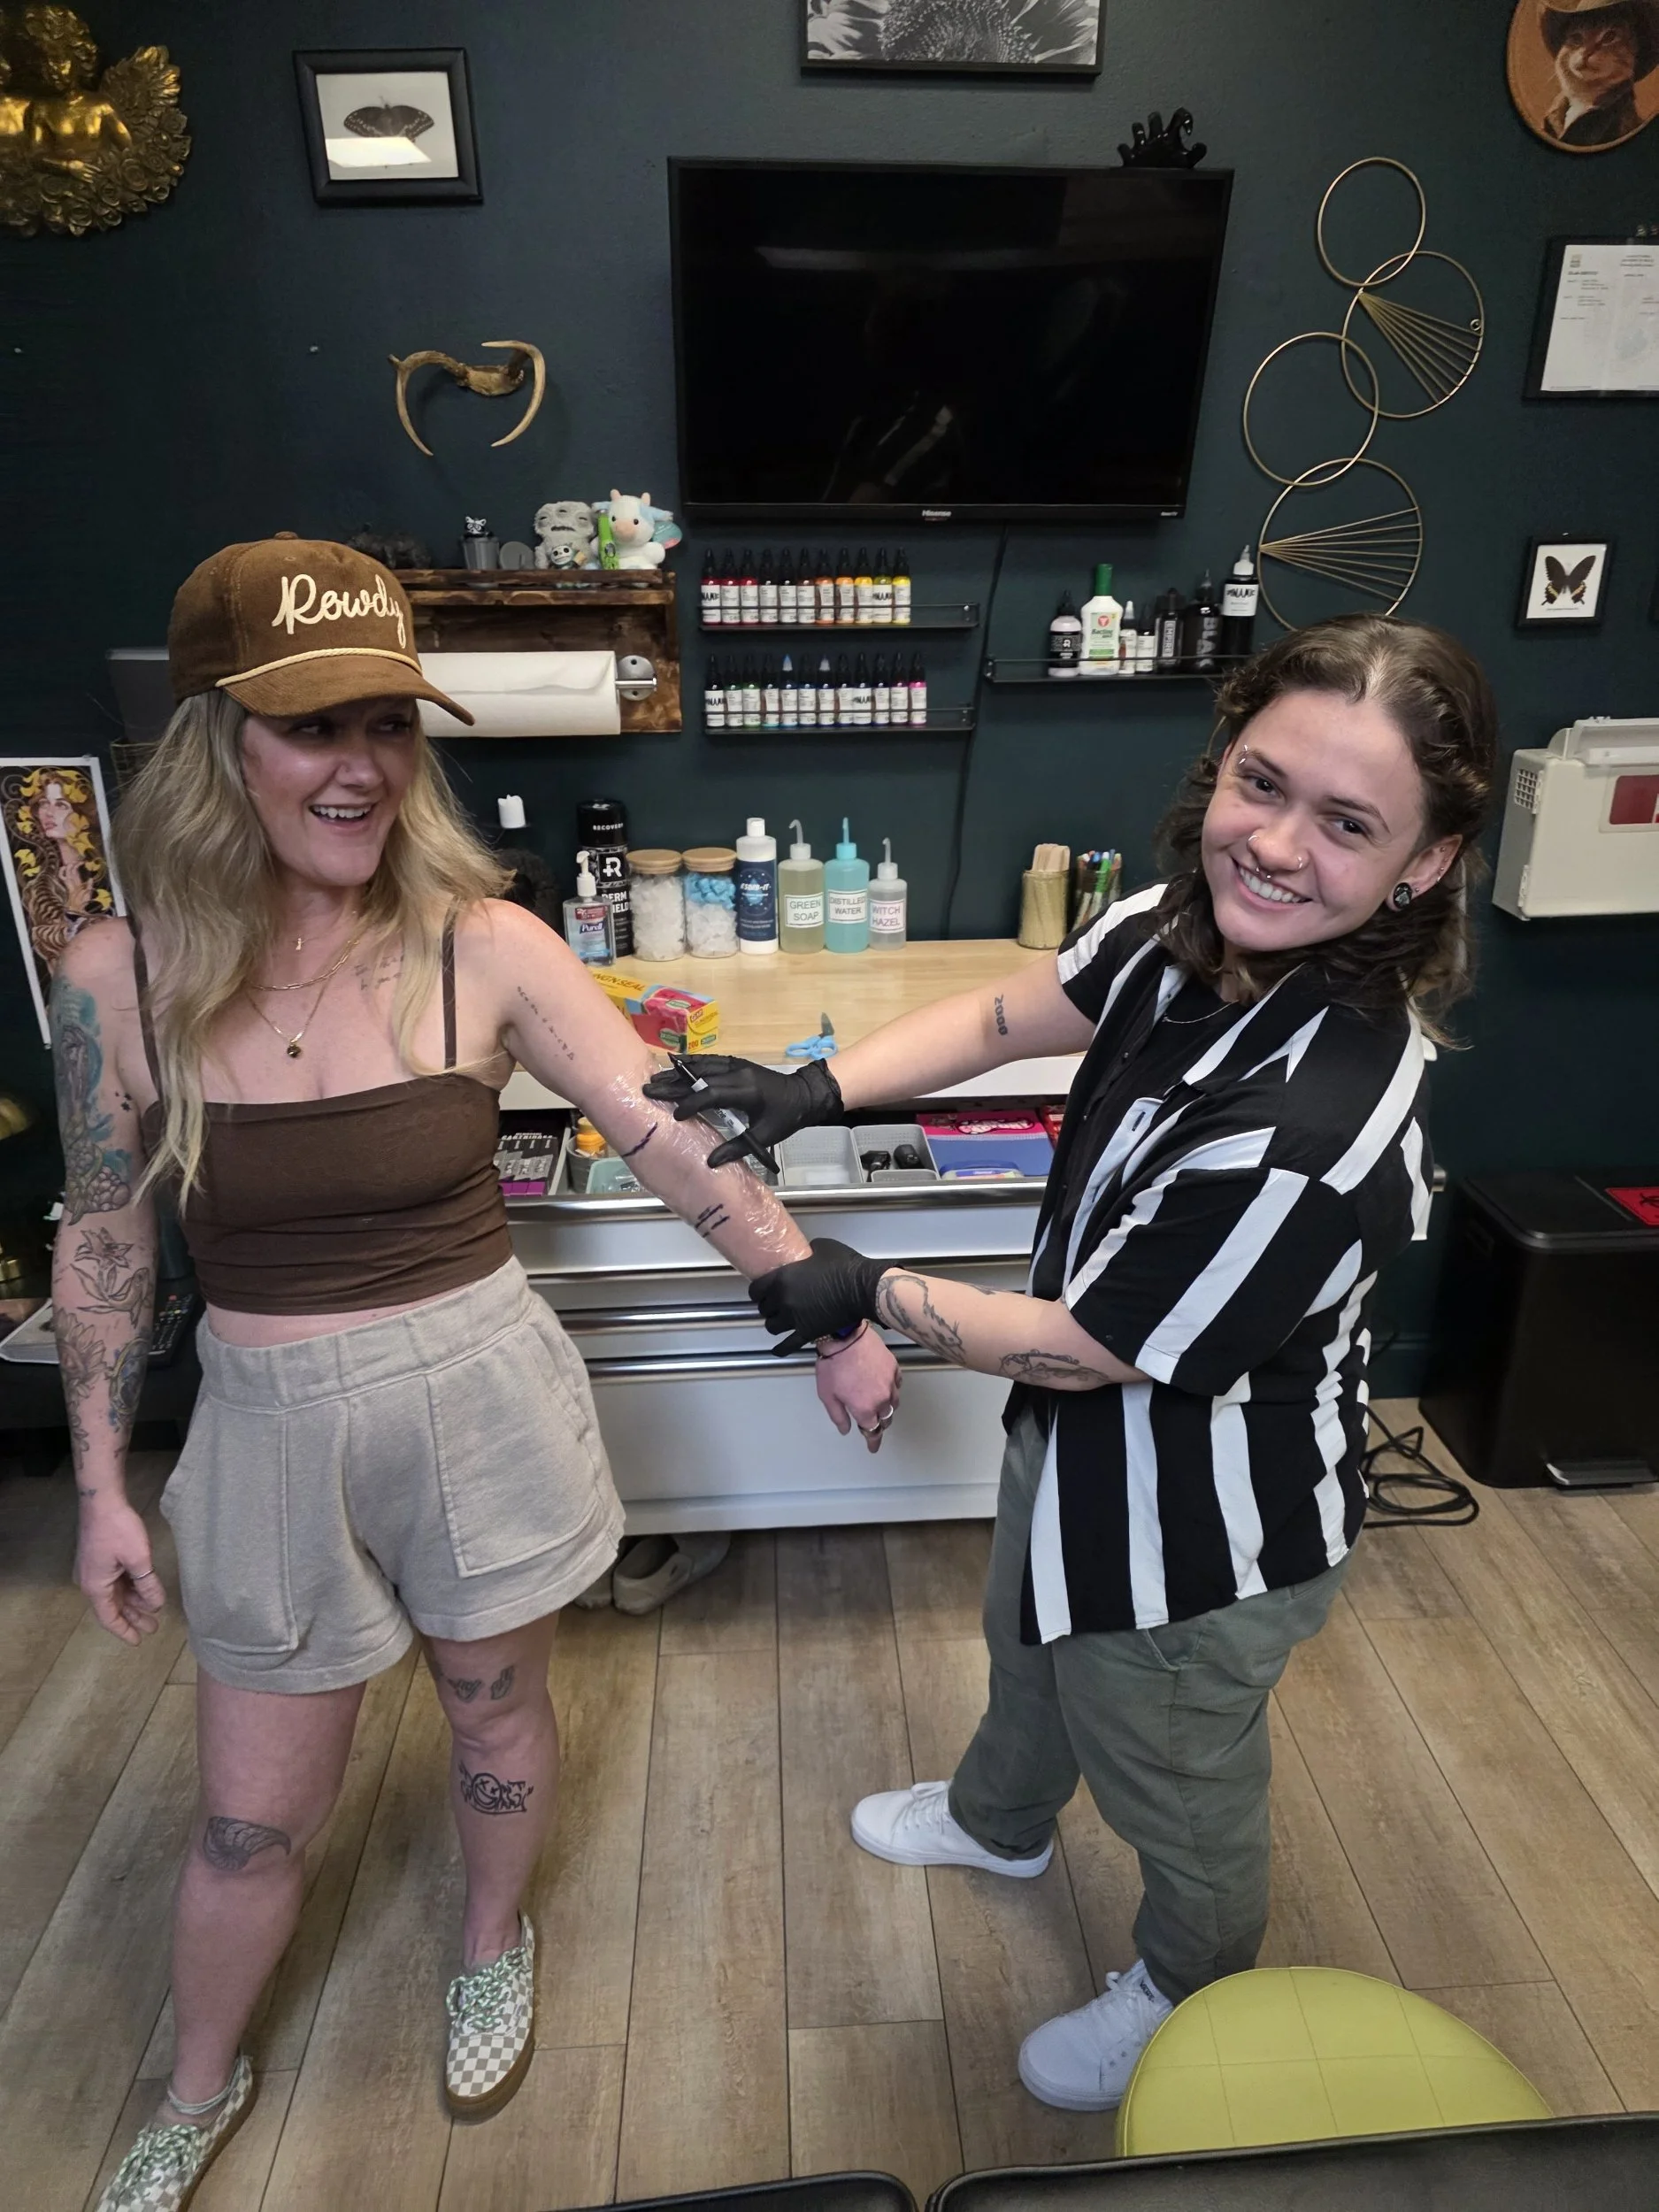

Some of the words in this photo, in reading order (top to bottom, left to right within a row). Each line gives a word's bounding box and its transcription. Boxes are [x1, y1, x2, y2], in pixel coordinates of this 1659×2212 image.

[272, 574, 406, 649] Rowdy
[789, 900, 821, 910] GREEN
[829, 896, 866, 905] DISTILLED
[612, 902, 629, 913] IELD
[872, 905, 901, 916] WITCH
[793, 911, 819, 921] SOAP
[872, 918, 901, 927] HAZEL
[618, 979, 646, 991] SEAL
[994, 994, 1008, 1036] 2000
